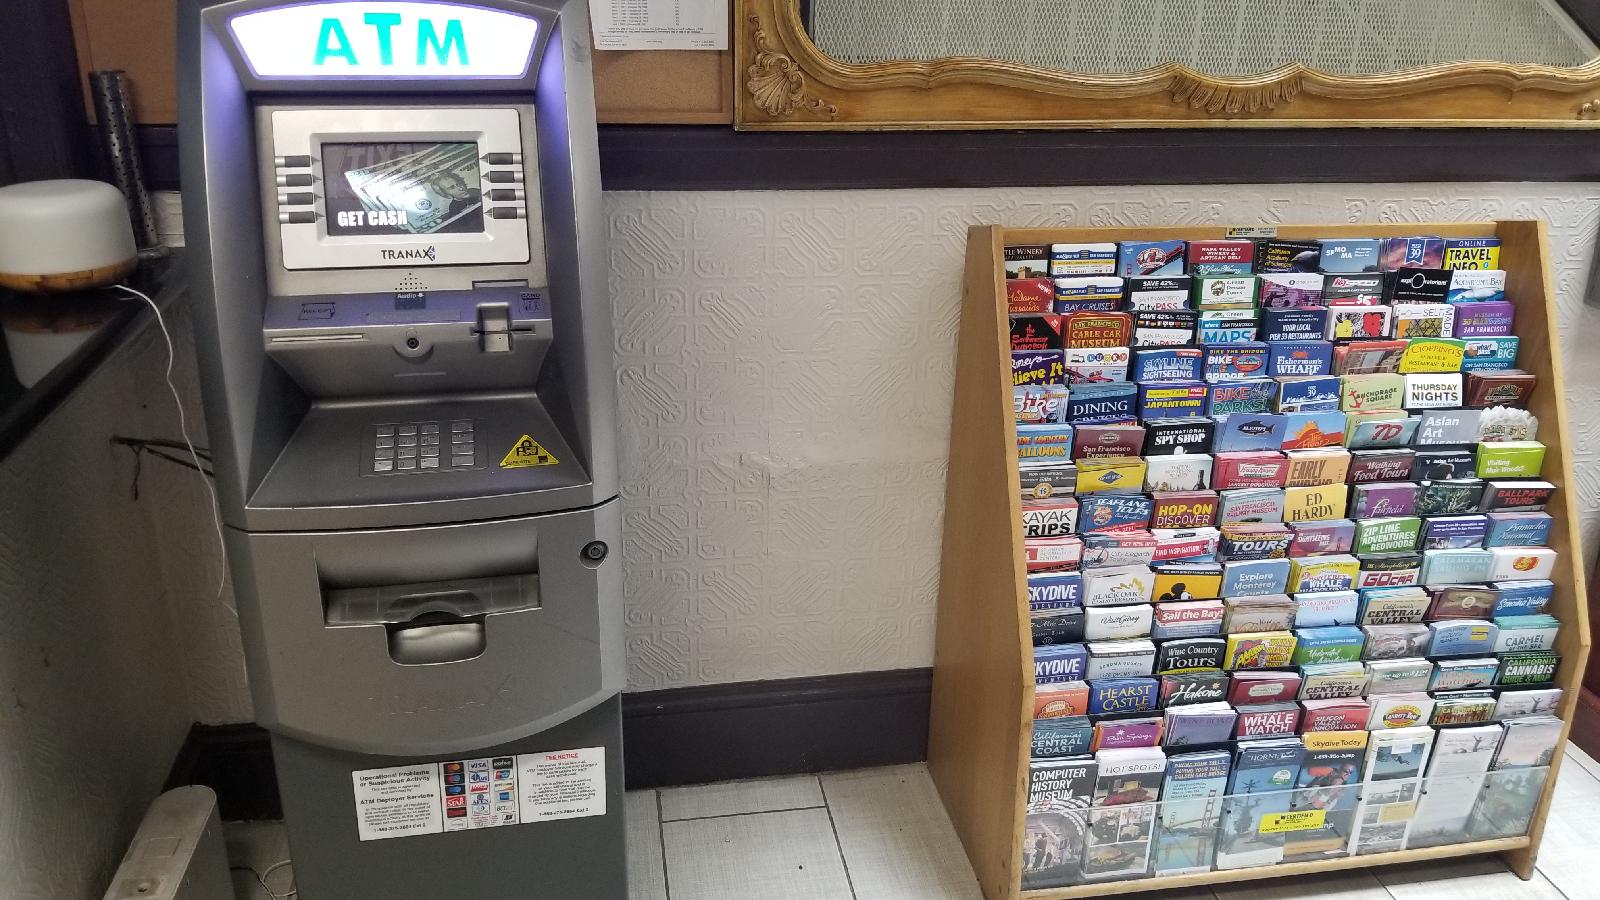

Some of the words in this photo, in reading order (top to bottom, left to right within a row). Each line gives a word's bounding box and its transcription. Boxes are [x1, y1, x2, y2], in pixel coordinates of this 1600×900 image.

[314, 13, 470, 66] ATM
[338, 211, 364, 227] GET
[368, 210, 408, 226] CASH
[381, 248, 433, 260] TRANAX
[1016, 247, 1043, 256] WINERY
[1408, 248, 1421, 259] 39
[1449, 250, 1492, 261] TRAVEL
[1449, 262, 1479, 270] INFO
[1064, 303, 1080, 311] BAY
[1081, 302, 1115, 311] CRUISES
[1422, 308, 1446, 317] SELF
[1073, 322, 1086, 330] SAN
[1087, 320, 1120, 329] FRANCISCO
[1443, 307, 1453, 336] MADE
[1296, 323, 1311, 331] LOCAL
[1476, 325, 1507, 333] FRANCISCO
[1072, 330, 1100, 339] CABLE
[1103, 330, 1121, 338] CAR
[1203, 330, 1251, 343] MAPS
[1269, 333, 1281, 341] PIER
[1287, 332, 1322, 340] RESTAURANTS
[1071, 338, 1121, 348] MUSEUM
[1476, 343, 1493, 351] wharf
[1499, 341, 1518, 349] SAVE
[1497, 349, 1515, 359] BIG
[1143, 357, 1195, 371] SKYLINE
[1207, 355, 1233, 365] BIKE
[1276, 356, 1324, 365] Fisherman's
[1050, 361, 1064, 377] It
[1276, 365, 1322, 375] WHARF
[1141, 370, 1194, 380] SIGHTSEEING
[1411, 383, 1458, 391] THURSDAY
[1213, 387, 1250, 401] BIKE
[1307, 389, 1317, 398] 39
[1356, 387, 1398, 400] ANCHORAGE
[1366, 394, 1393, 403] SQUARE
[1411, 391, 1459, 401] NIGHTS
[1072, 400, 1129, 416] DINING
[1143, 399, 1202, 409] JAPANTOWN
[1212, 399, 1268, 415] PARKS!
[1424, 416, 1460, 427] Asian
[1422, 427, 1443, 438] Art
[1154, 435, 1178, 446] SPY
[1178, 433, 1207, 444] SHOP
[1097, 445, 1132, 453] Francisco
[1366, 460, 1402, 471] Walking
[1487, 459, 1510, 467] Visiting
[1290, 459, 1328, 480] EARLY
[1354, 469, 1377, 481] Food
[1380, 468, 1409, 479] Tours
[1305, 492, 1323, 505] ED
[1497, 489, 1549, 498] BALLPARK
[1094, 498, 1150, 509] SEAPLANE
[1503, 497, 1536, 505] TOURS
[1115, 505, 1151, 516] TOURS
[1158, 503, 1213, 517] HOP-ON
[1249, 505, 1278, 514] MUSEUM
[1292, 504, 1336, 520] HARDY
[1156, 513, 1211, 526] DISCOVER
[1363, 526, 1378, 538] ZIP
[1379, 523, 1401, 534] LINE
[1361, 532, 1416, 545] ADVENTURES
[1232, 540, 1288, 552] TOURS
[1370, 540, 1415, 551] REDWOODS
[1155, 546, 1169, 556] FIND
[1239, 572, 1273, 582] Explore
[1232, 581, 1277, 591] Monterey
[1309, 579, 1343, 588] WHALE
[1028, 584, 1078, 601] SKYDIVE
[1092, 592, 1119, 601] BLACK
[1120, 591, 1140, 599] OAK
[1161, 611, 1180, 621] Sail
[1182, 609, 1200, 619] the
[1201, 608, 1225, 619] Bay!
[1367, 609, 1422, 618] CENTRAL
[1371, 616, 1416, 625] VALLEY
[1505, 634, 1545, 647] CARMEL
[1168, 647, 1186, 656] Wine
[1187, 645, 1219, 656] Country
[1034, 658, 1082, 676] KYDIVE
[1166, 655, 1216, 670] Tours
[1507, 657, 1556, 667] CALIFORNIA
[1504, 664, 1555, 676] CANNABIS
[1501, 674, 1524, 684] GUIDE
[1099, 685, 1153, 701] HEARST
[1170, 683, 1224, 701] Hakone
[1305, 684, 1360, 694] CENTRAL
[1102, 696, 1150, 711] CASTLE
[1244, 713, 1295, 727] WHALE
[1313, 719, 1342, 727] VALLEY
[1315, 714, 1346, 722] SILICON
[1245, 723, 1290, 736] WATCH
[1312, 723, 1358, 731] INNOVATION
[1033, 730, 1082, 740] California's
[1031, 738, 1083, 748] CENTRAL
[1311, 740, 1340, 749] Skydive
[1340, 739, 1362, 748] Today
[1035, 746, 1073, 755] COAST
[1105, 765, 1127, 774] HOT
[1128, 763, 1162, 773] SPOTS!
[1032, 767, 1087, 782] COMPUTER
[406, 776, 430, 784] Activity
[1031, 778, 1073, 792] HISTORY
[1030, 789, 1073, 802] MUSEUM
